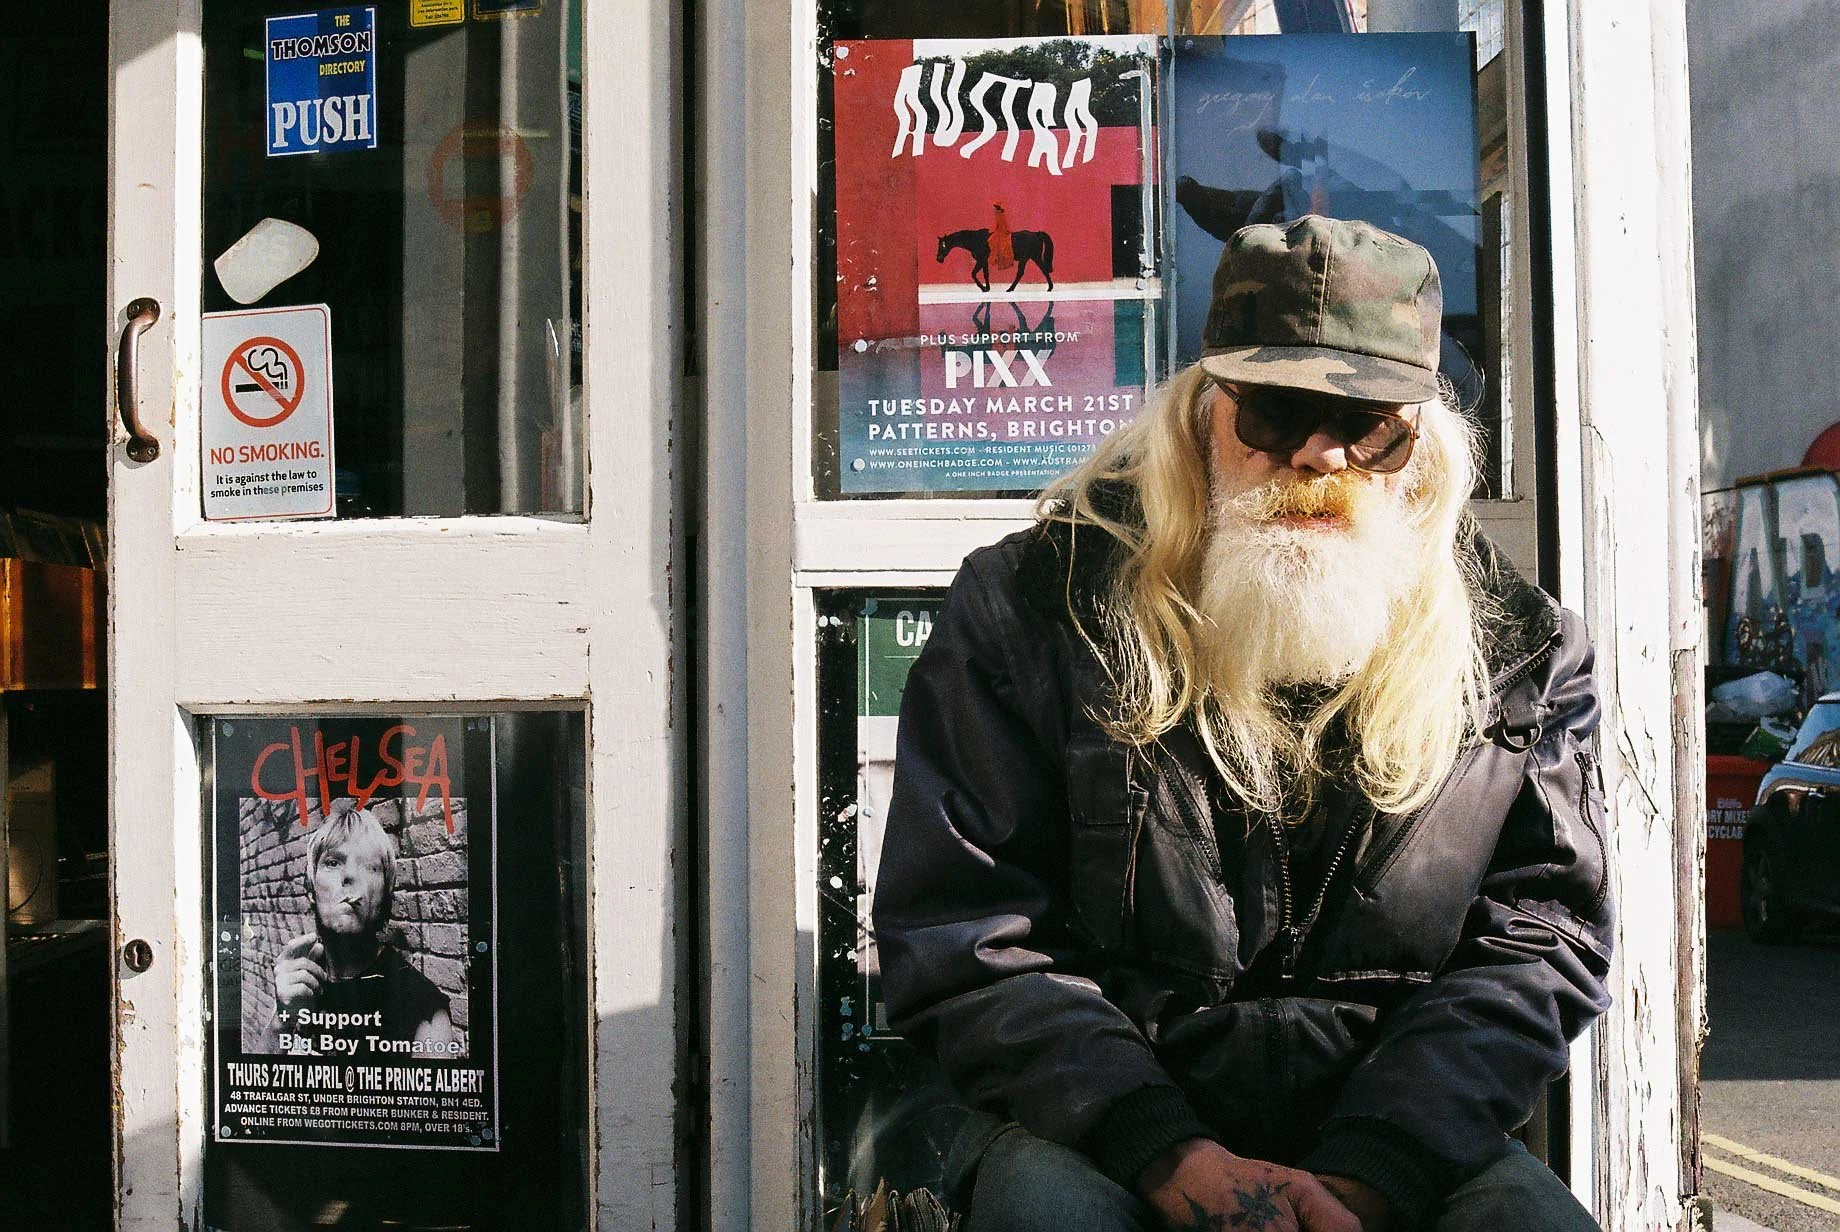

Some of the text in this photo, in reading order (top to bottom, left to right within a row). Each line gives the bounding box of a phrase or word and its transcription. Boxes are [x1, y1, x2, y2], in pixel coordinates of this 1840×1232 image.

[334, 15, 350, 27] THE
[271, 30, 371, 60] THOMSON
[319, 60, 365, 77] DIRECTORY
[272, 94, 371, 148] PUSH
[891, 58, 1099, 176] AUSTRA
[920, 331, 1080, 346] PLUS SUPPORT FROM
[945, 349, 1053, 389] PIXX
[868, 394, 1133, 416] TUESDAY MARCH 21ST
[868, 421, 997, 442] PATTERNS,
[210, 441, 325, 465] NO SMOKING.
[869, 446, 976, 457] WWW.SEETICKETS.COM
[985, 446, 1031, 454] RESIDENT
[1035, 444, 1065, 454] MUSIC
[869, 458, 1003, 469] WWW.ONEINCHBADGE.COM
[1011, 469, 1060, 477] PRESENTATION
[216, 470, 317, 487] It is against the law to
[210, 482, 324, 498] smoke in these premises
[895, 610, 940, 647] CA
[252, 725, 455, 835] CHELSEA
[298, 1008, 382, 1030] Support
[279, 1033, 312, 1054] Big
[320, 1034, 359, 1056] Boy
[227, 1062, 485, 1093] THURS 27TH APRIL @ THE PRINCE ALBERT
[230, 1091, 241, 1101] 48
[243, 1091, 296, 1102] TRAFALGAR
[298, 1093, 311, 1104] ST,
[313, 1094, 344, 1104] UNDER
[347, 1095, 395, 1105] BRIGHTON
[396, 1096, 439, 1108] STATION,
[441, 1097, 459, 1107] BN1
[224, 1104, 267, 1113] ADVANCE
[269, 1105, 308, 1115] TICKETS
[323, 1107, 348, 1117] FROM
[350, 1107, 389, 1118] PUNKER
[391, 1109, 429, 1119] BUNKER
[432, 1110, 439, 1119] &
[240, 1116, 275, 1127] ONLINE
[277, 1118, 303, 1127] FROM
[304, 1119, 399, 1131] WEGOTTICKETS.COM
[425, 1123, 450, 1133] OVER
